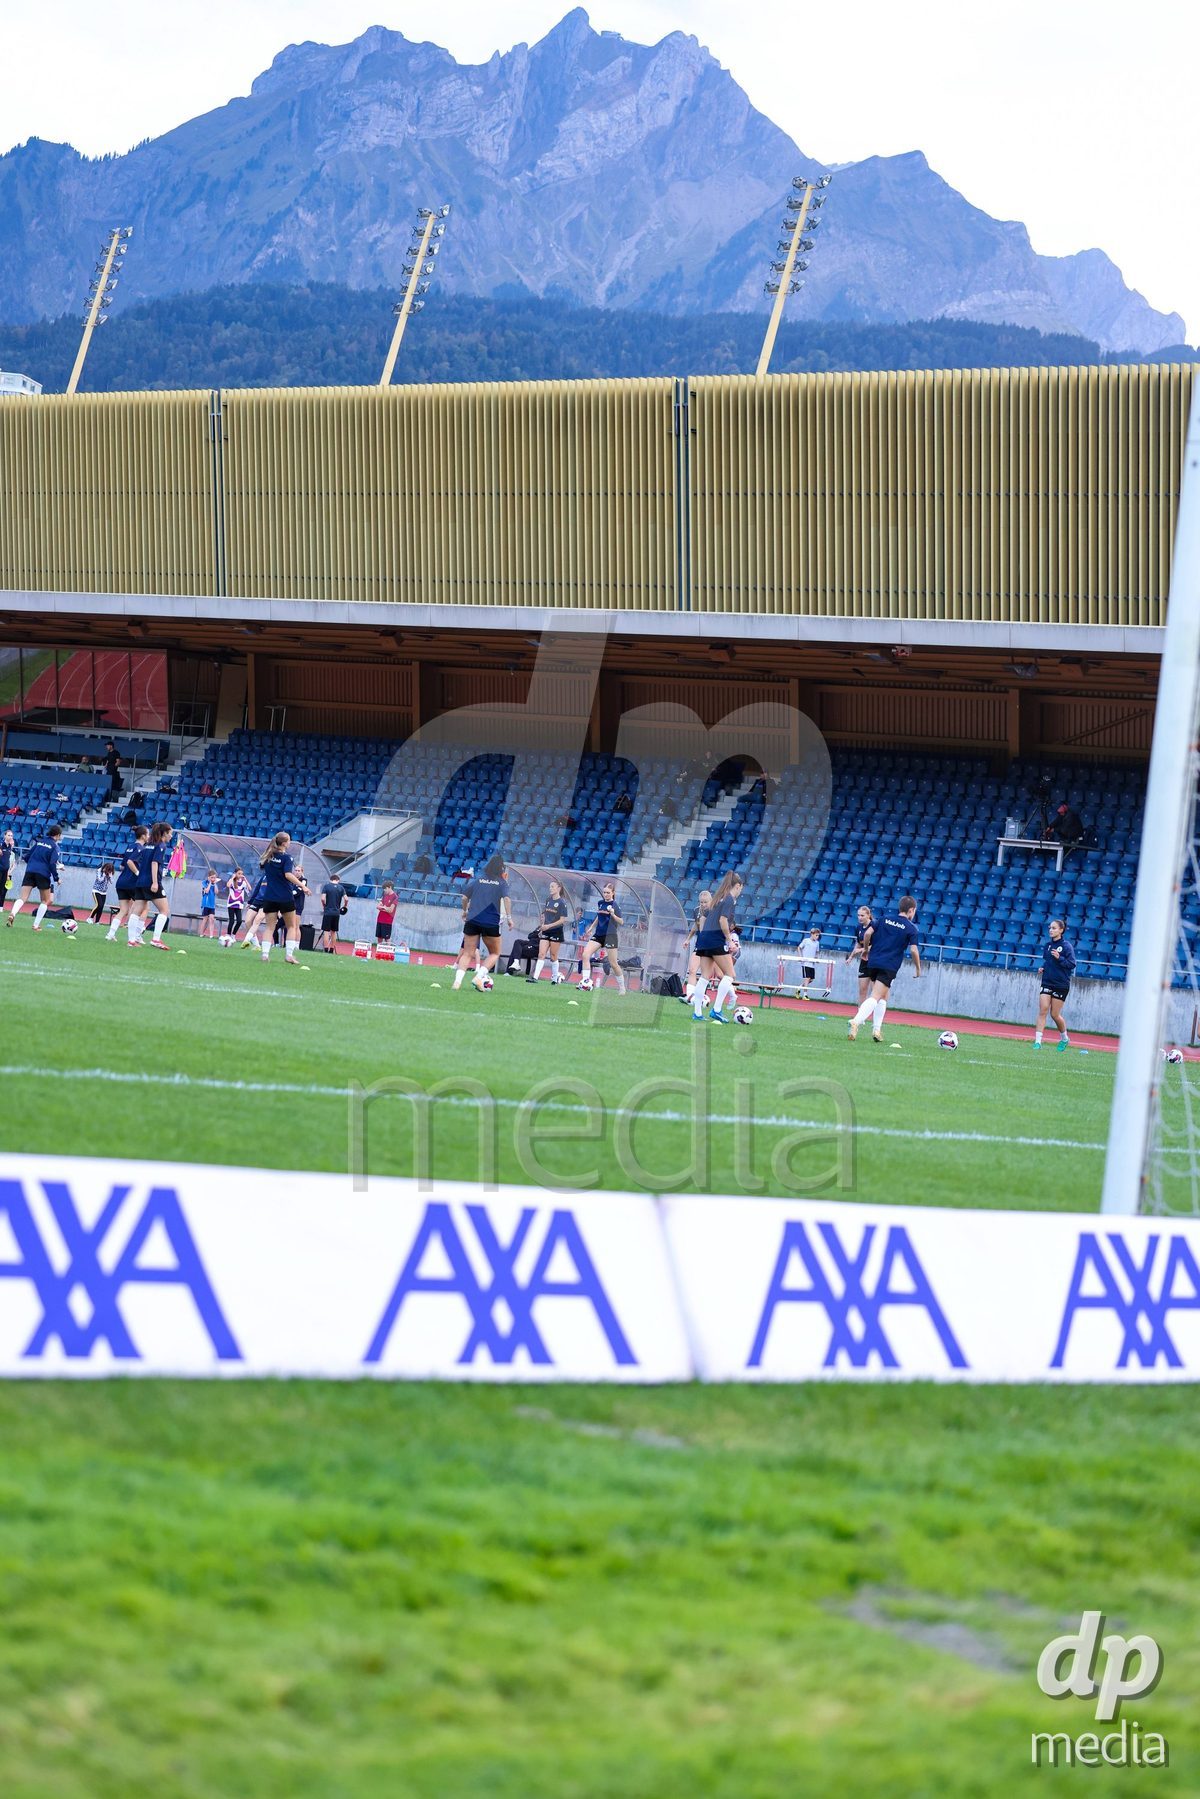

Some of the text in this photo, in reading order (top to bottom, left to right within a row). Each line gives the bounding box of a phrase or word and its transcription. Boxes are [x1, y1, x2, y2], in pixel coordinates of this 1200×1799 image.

[885, 919, 905, 929] ValJob
[362, 1202, 638, 1366] AXA
[746, 1220, 970, 1368] AXA
